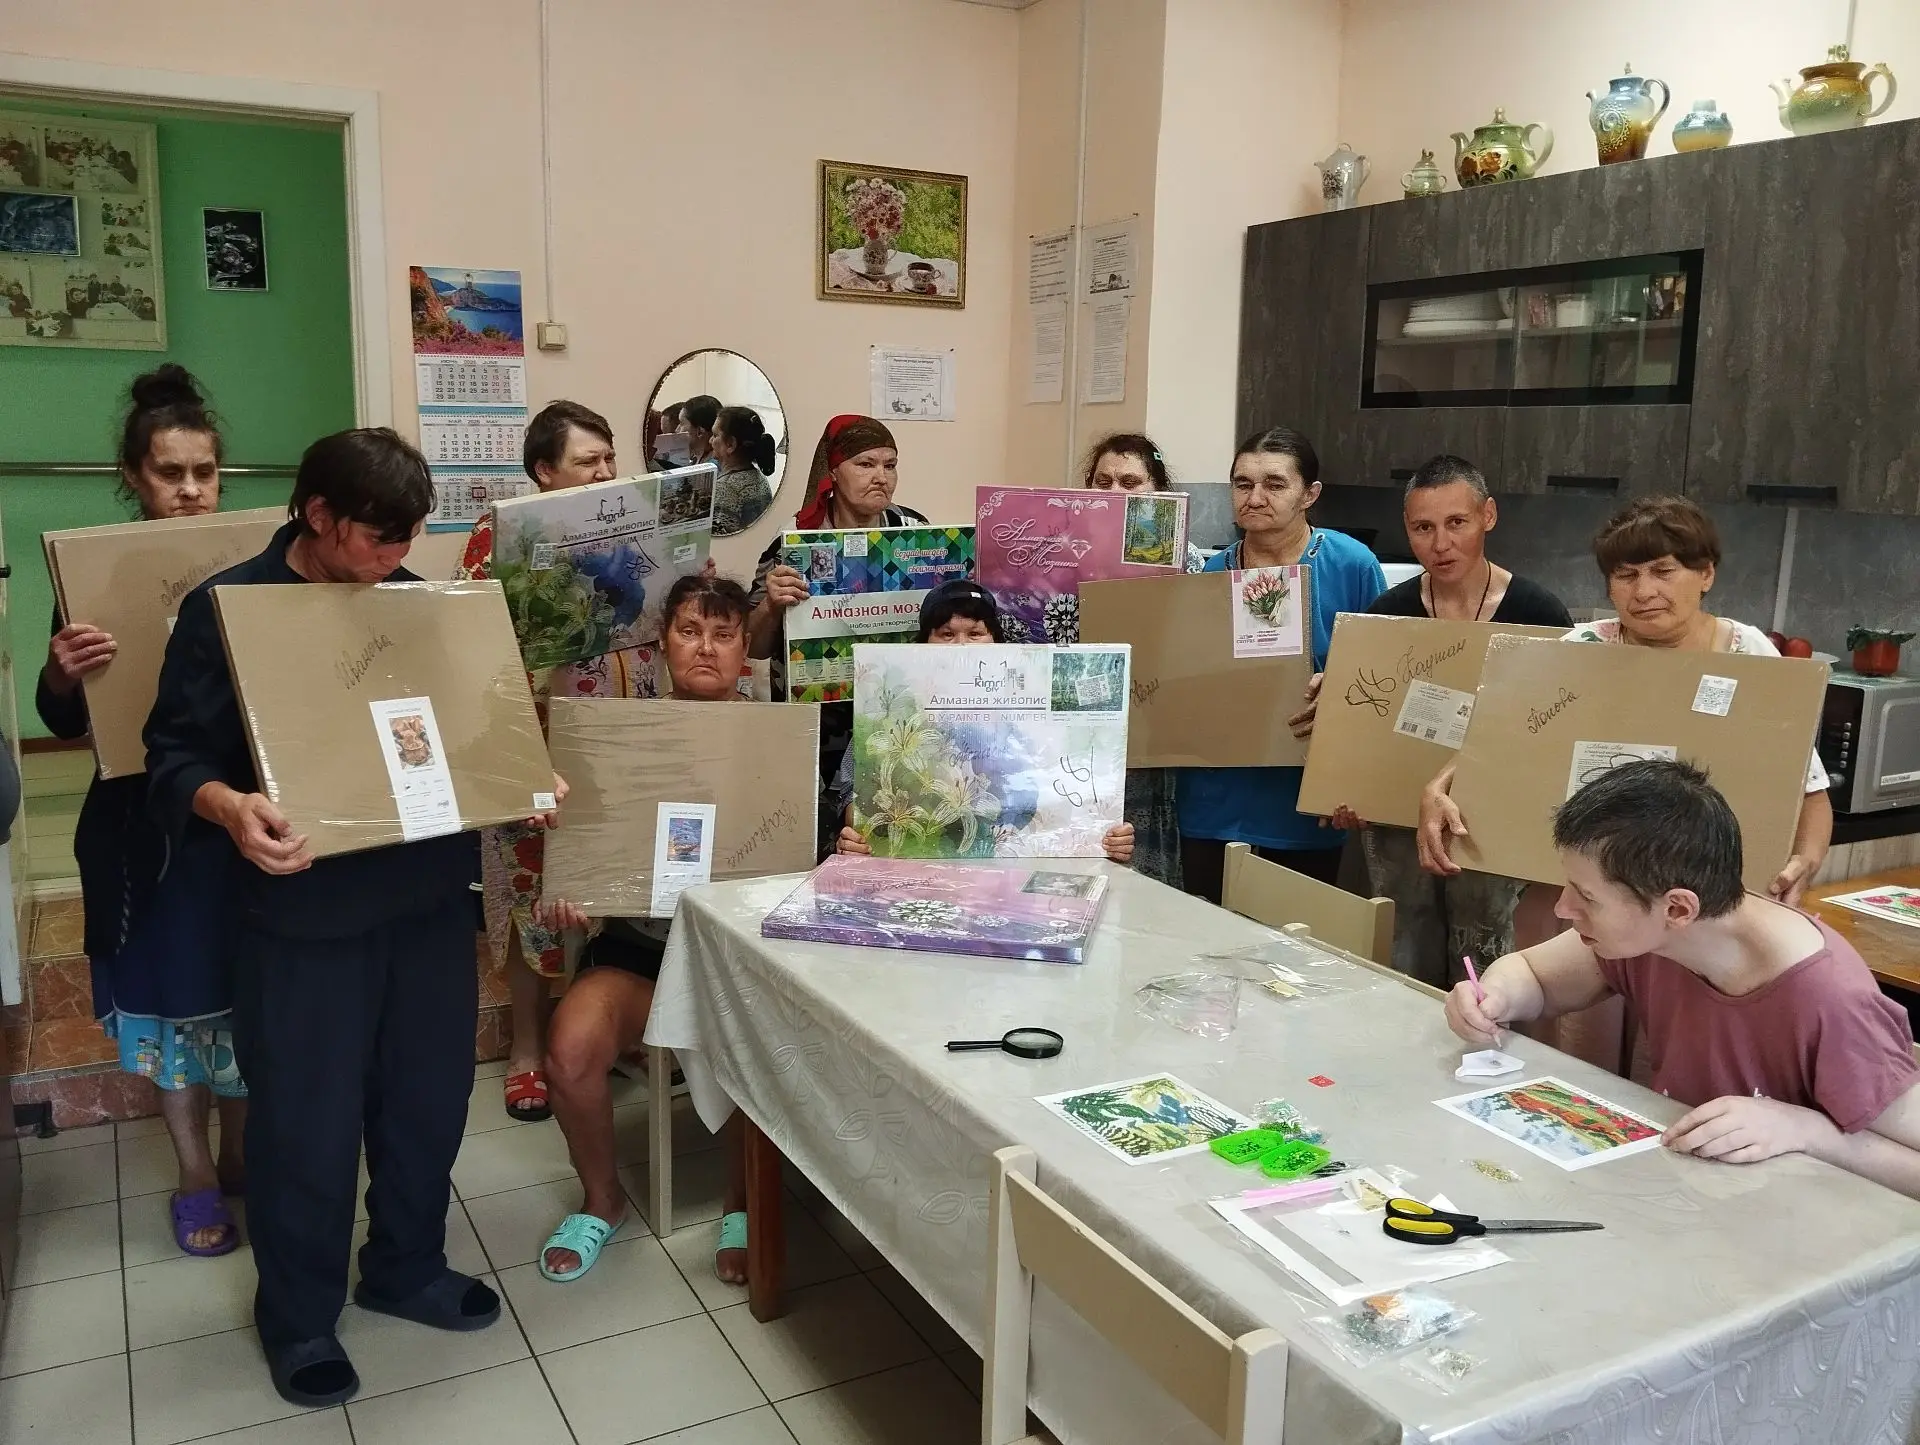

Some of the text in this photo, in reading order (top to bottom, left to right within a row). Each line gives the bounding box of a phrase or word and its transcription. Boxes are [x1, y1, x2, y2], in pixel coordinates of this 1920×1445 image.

[560, 529, 609, 543] Алмазная
[617, 532, 654, 545] NUMER
[894, 548, 948, 561] Создай шедевр
[1007, 543, 1079, 574] Мозаика
[908, 565, 936, 575] своими
[811, 605, 888, 619] Алмазная
[850, 621, 872, 629] Набор
[930, 695, 1047, 705] Алмазная живопис
[1001, 713, 1047, 722] NUMER
